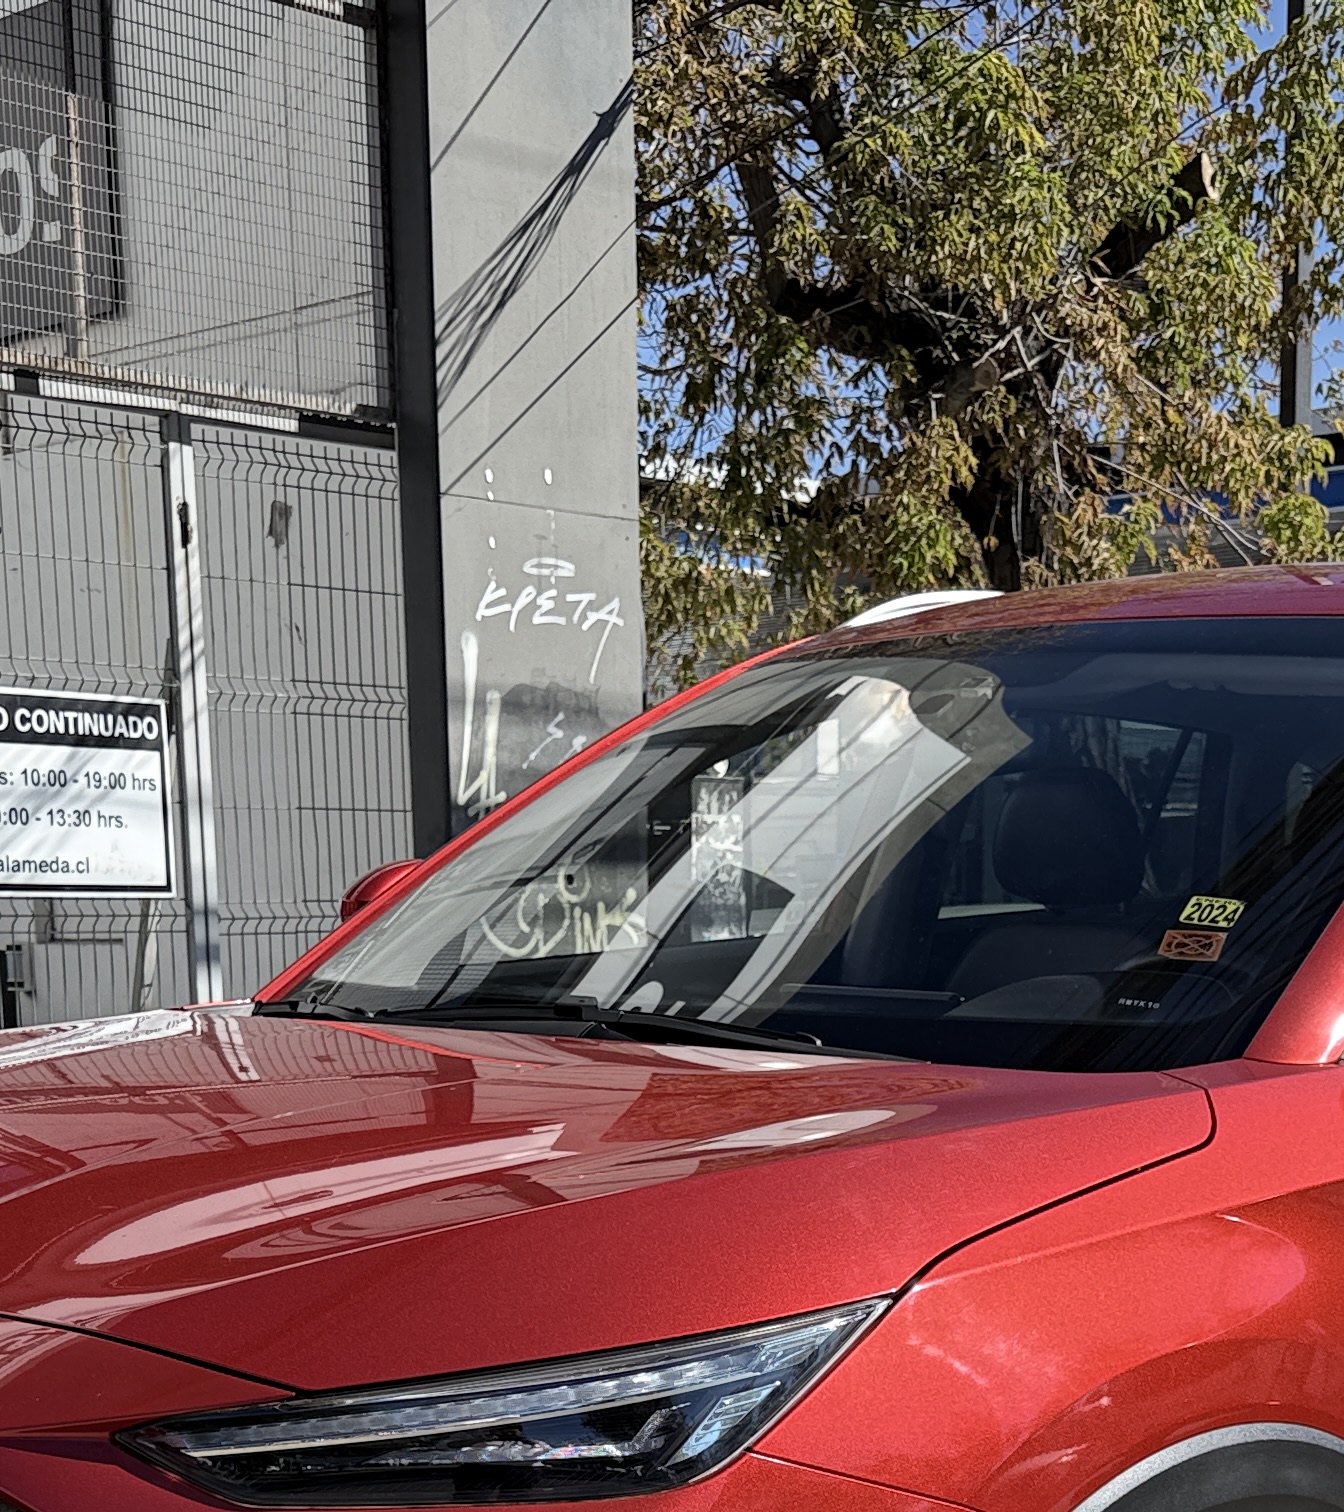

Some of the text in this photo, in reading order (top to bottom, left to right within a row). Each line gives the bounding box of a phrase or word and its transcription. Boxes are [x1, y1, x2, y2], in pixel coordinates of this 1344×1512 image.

[14, 708, 159, 740] CONTINUADO
[20, 768, 67, 787] 10:00
[83, 771, 127, 790] 19:00
[132, 773, 157, 792] hrs
[47, 808, 92, 828] 13:30
[97, 810, 129, 829] hrs.
[1182, 901, 1241, 927] 2024
